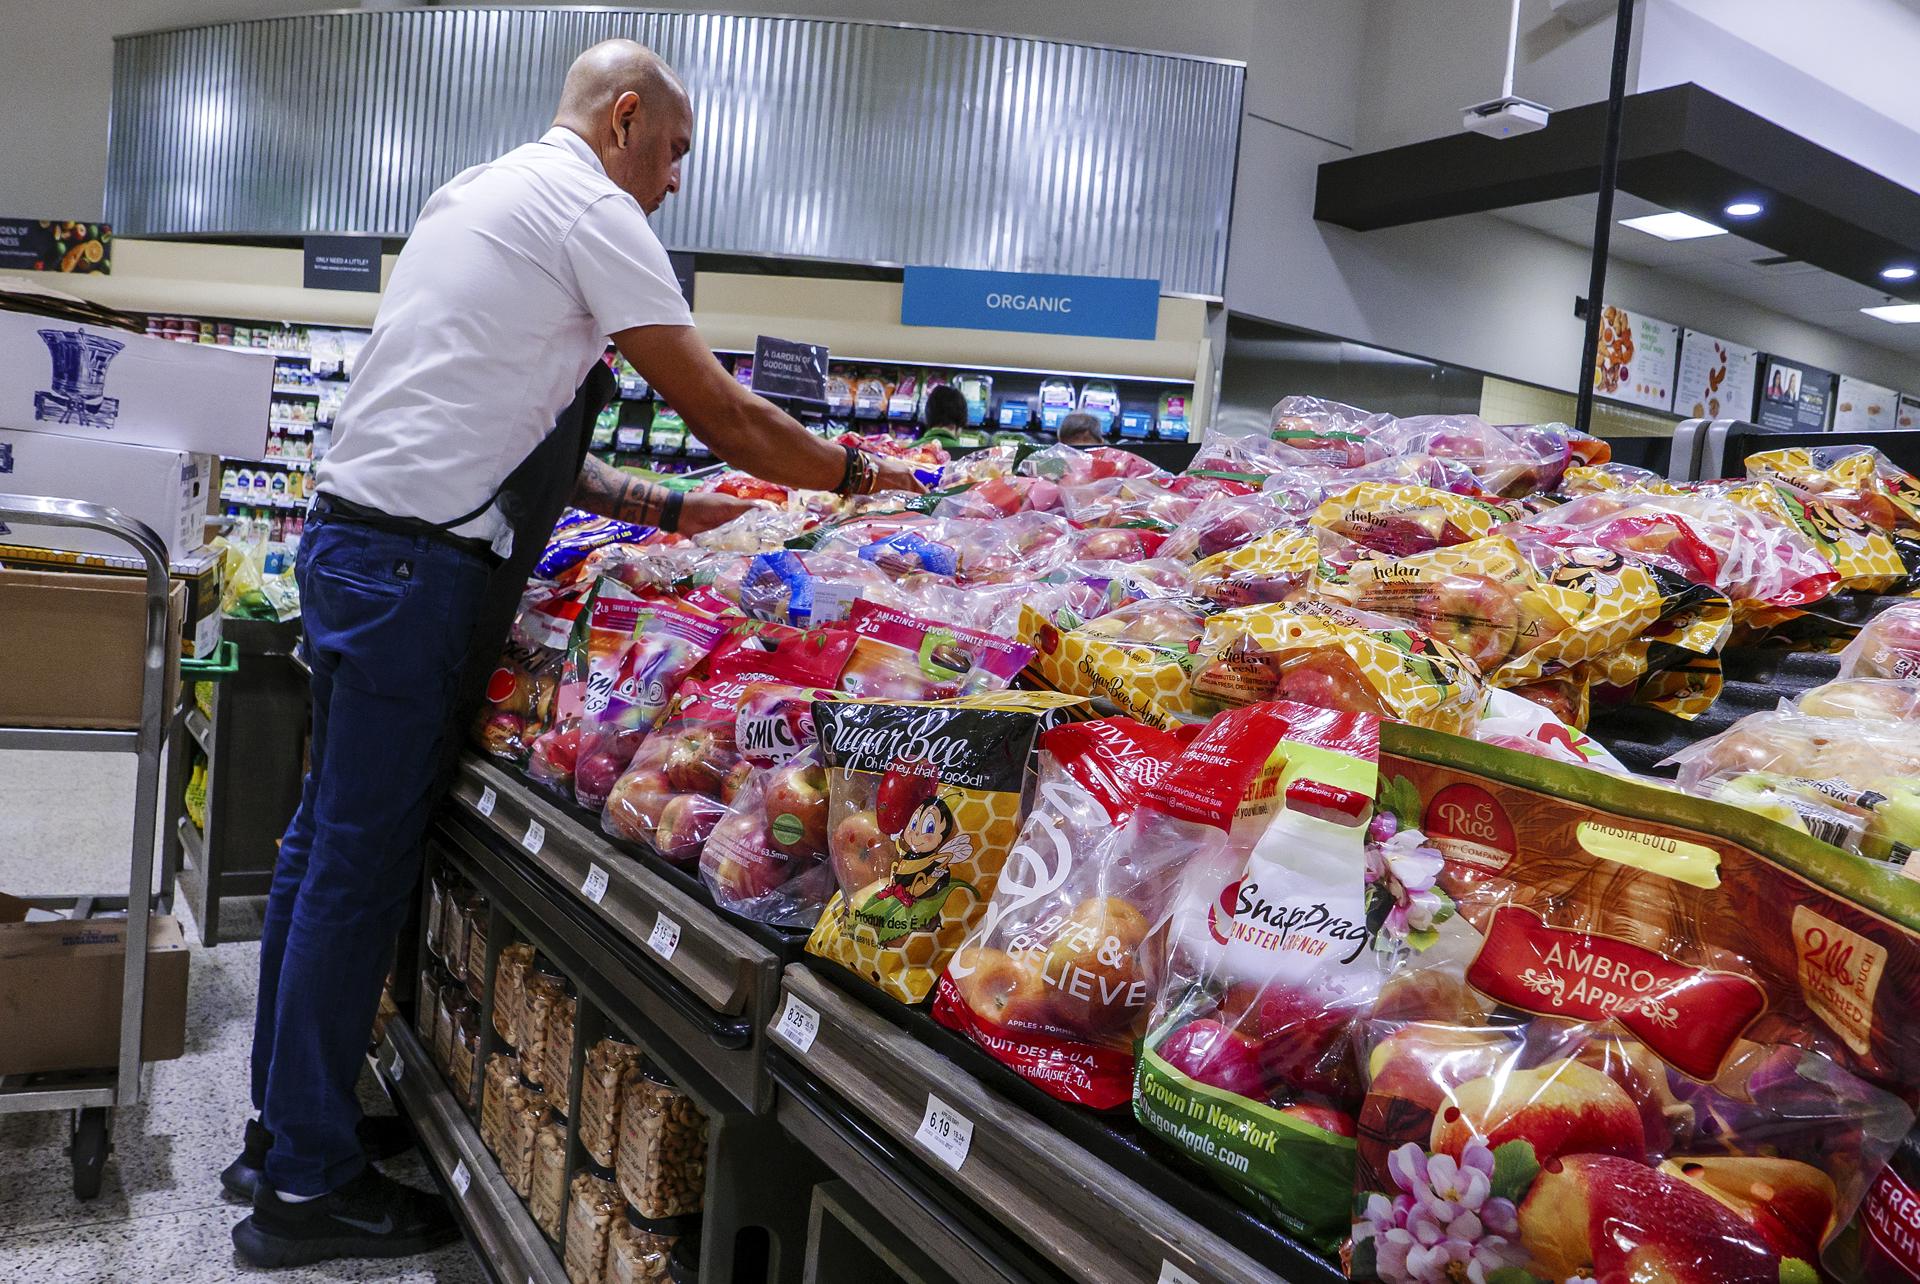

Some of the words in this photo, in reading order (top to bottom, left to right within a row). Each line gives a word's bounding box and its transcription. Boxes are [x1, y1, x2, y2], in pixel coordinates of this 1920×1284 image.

[986, 293, 1072, 313] ORGANIC
[763, 359, 803, 374] GOODNESS
[764, 350, 770, 358] A
[771, 351, 801, 362] GARDEN
[1345, 508, 1389, 529] chelan
[1372, 561, 1421, 581] helan
[876, 610, 914, 629] AMAZING
[916, 622, 945, 637] FLAVO
[1217, 646, 1272, 666] chelan
[822, 708, 968, 781] SugarBee
[1083, 718, 1146, 766] envy
[864, 756, 878, 769] Oh
[912, 762, 943, 780] that's
[1173, 785, 1196, 799] SAVOIR
[1194, 793, 1209, 803] PLUS
[1208, 797, 1223, 808] SUR
[1438, 802, 1498, 842] Rice
[1460, 844, 1505, 863] COMPANY
[854, 909, 885, 928] Produit
[887, 917, 907, 930] des
[1235, 883, 1370, 965] SnapDrag
[1036, 914, 1097, 954] BITE
[1096, 934, 1124, 970] &
[1006, 932, 1148, 1008] BELIEVE
[1007, 1018, 1038, 1030] APPLES
[1017, 1044, 1048, 1059] DES
[1017, 1065, 1027, 1077] DE
[1027, 1065, 1067, 1083] FANTAISIE
[929, 1111, 950, 1137] 6.19
[1144, 1073, 1187, 1113] Grown
[1187, 1096, 1205, 1121] in
[1206, 1104, 1242, 1136] New
[1242, 1119, 1280, 1154] York
[1867, 1194, 1920, 1264] EALTH
